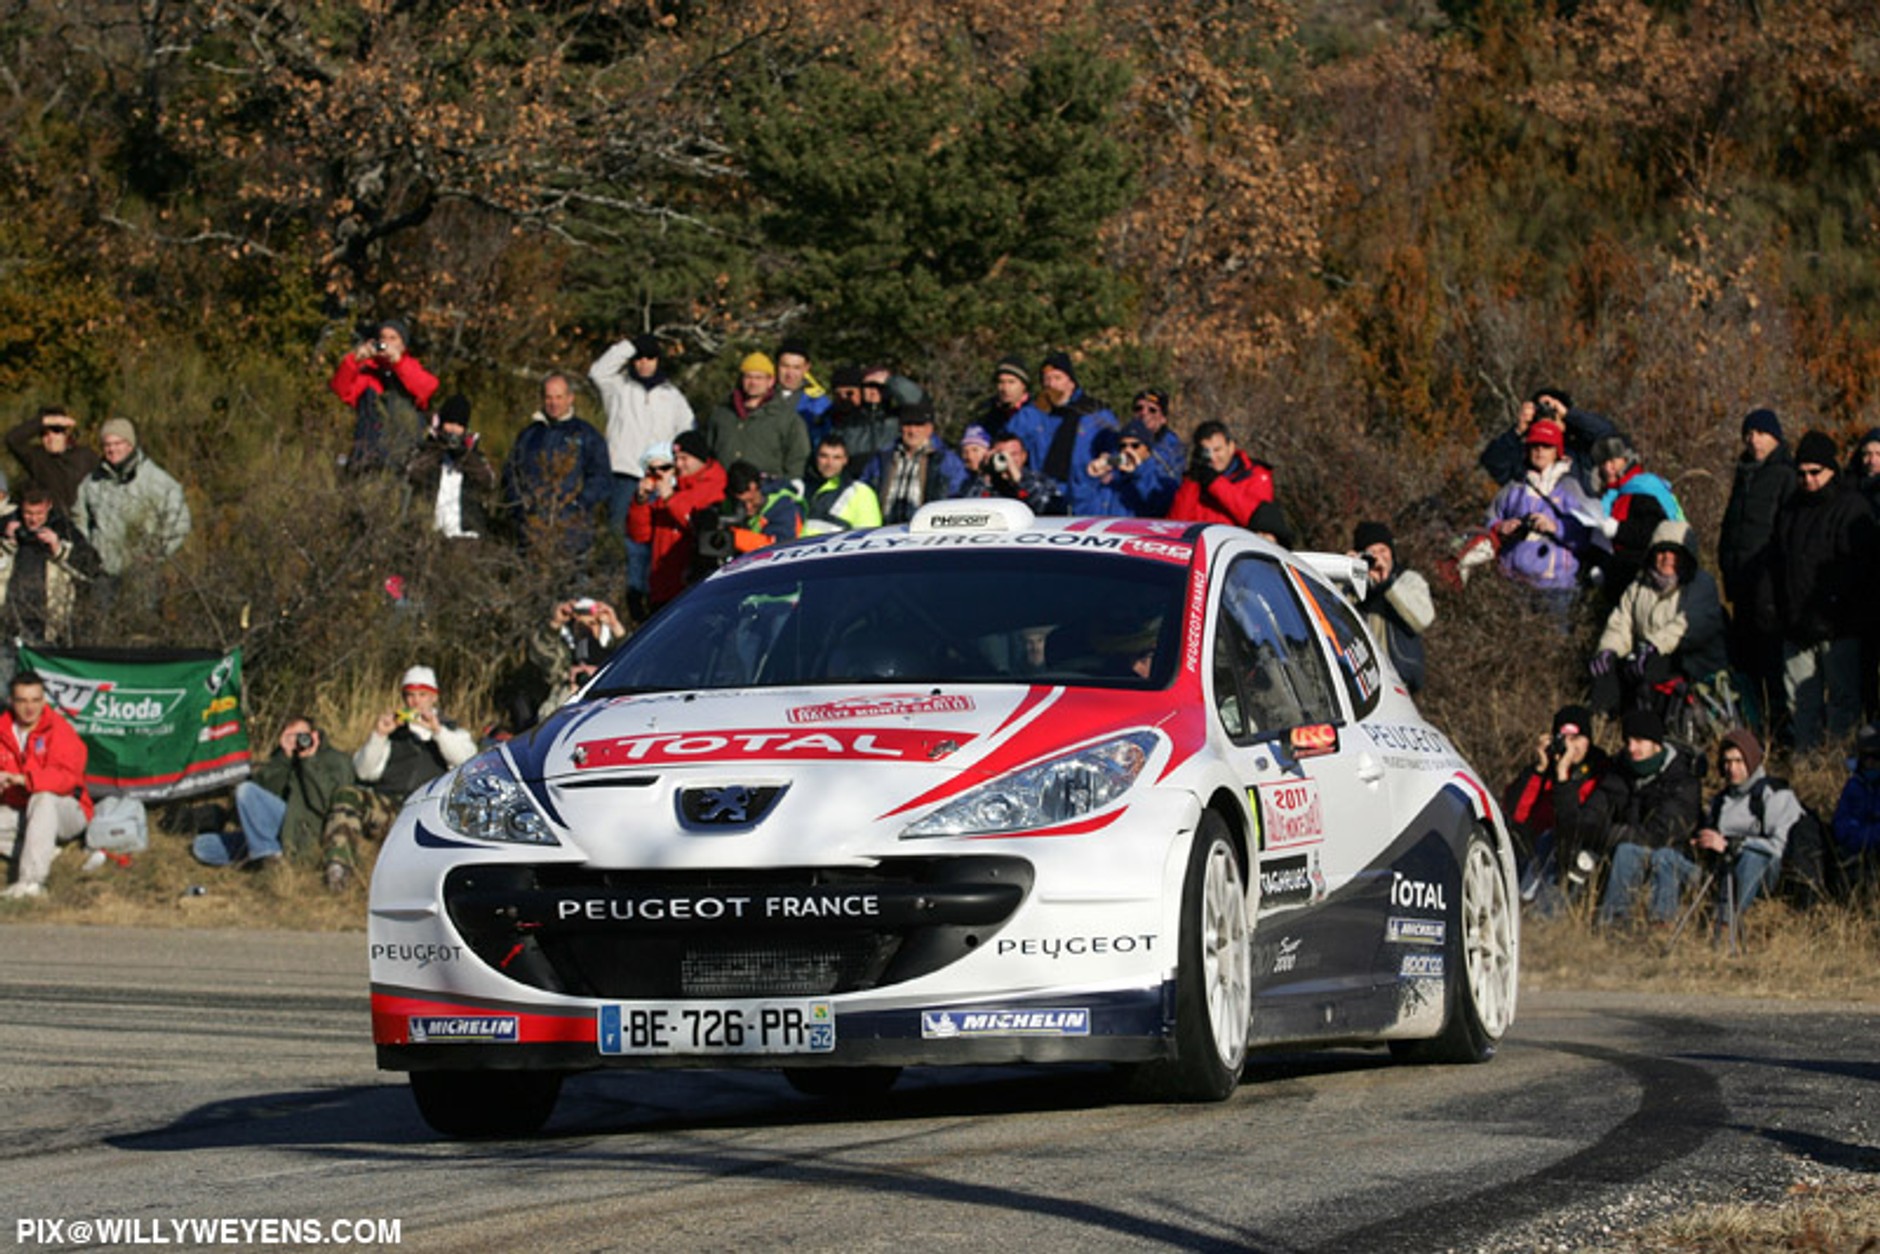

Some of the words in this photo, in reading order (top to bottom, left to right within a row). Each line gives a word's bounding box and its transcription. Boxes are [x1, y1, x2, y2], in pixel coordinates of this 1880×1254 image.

[771, 533, 1122, 562] RALLY-IRC.COM
[615, 732, 903, 759] TOTAL
[1273, 787, 1308, 810] 2011
[1390, 872, 1447, 911] TOTAL
[558, 897, 751, 920] PEUGEOT
[765, 895, 880, 918] FRANCE
[371, 943, 463, 969] PEUGEOT
[997, 934, 1159, 959] PEUGEOT
[427, 1018, 515, 1037] MICHELIN
[629, 1008, 803, 1048] BE-726-PR
[962, 1011, 1086, 1032] MICHELIN
[812, 1027, 832, 1048] 52
